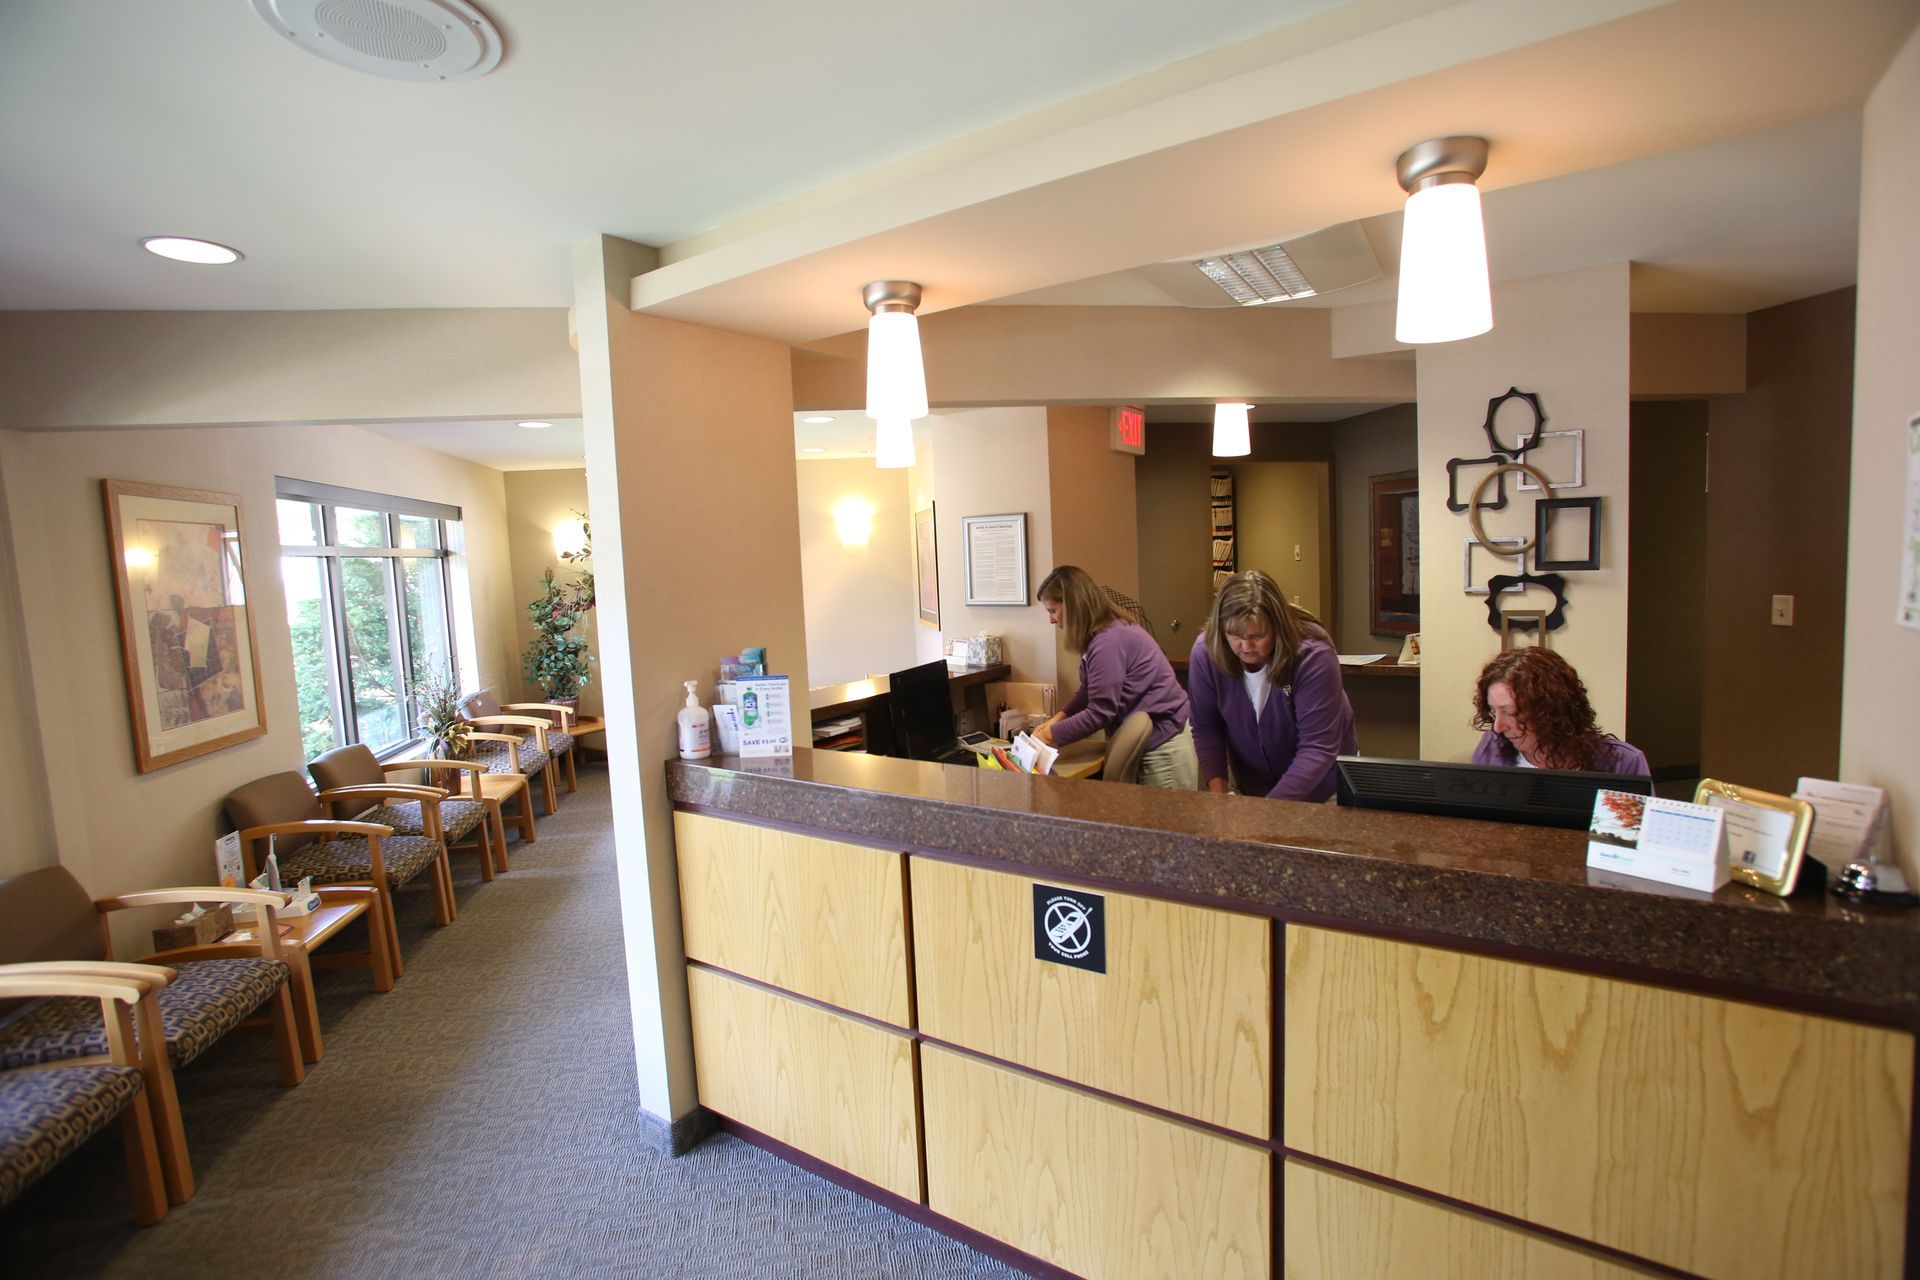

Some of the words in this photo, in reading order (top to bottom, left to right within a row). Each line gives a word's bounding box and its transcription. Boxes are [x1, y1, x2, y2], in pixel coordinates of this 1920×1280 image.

[1121, 410, 1143, 448] EXIT
[1449, 776, 1516, 798] acer
[1046, 895, 1063, 905] PLEASE
[1063, 896, 1077, 904] TURN
[1077, 901, 1087, 910] OFF
[1048, 941, 1061, 954] YOUR
[1061, 951, 1073, 959] CELL
